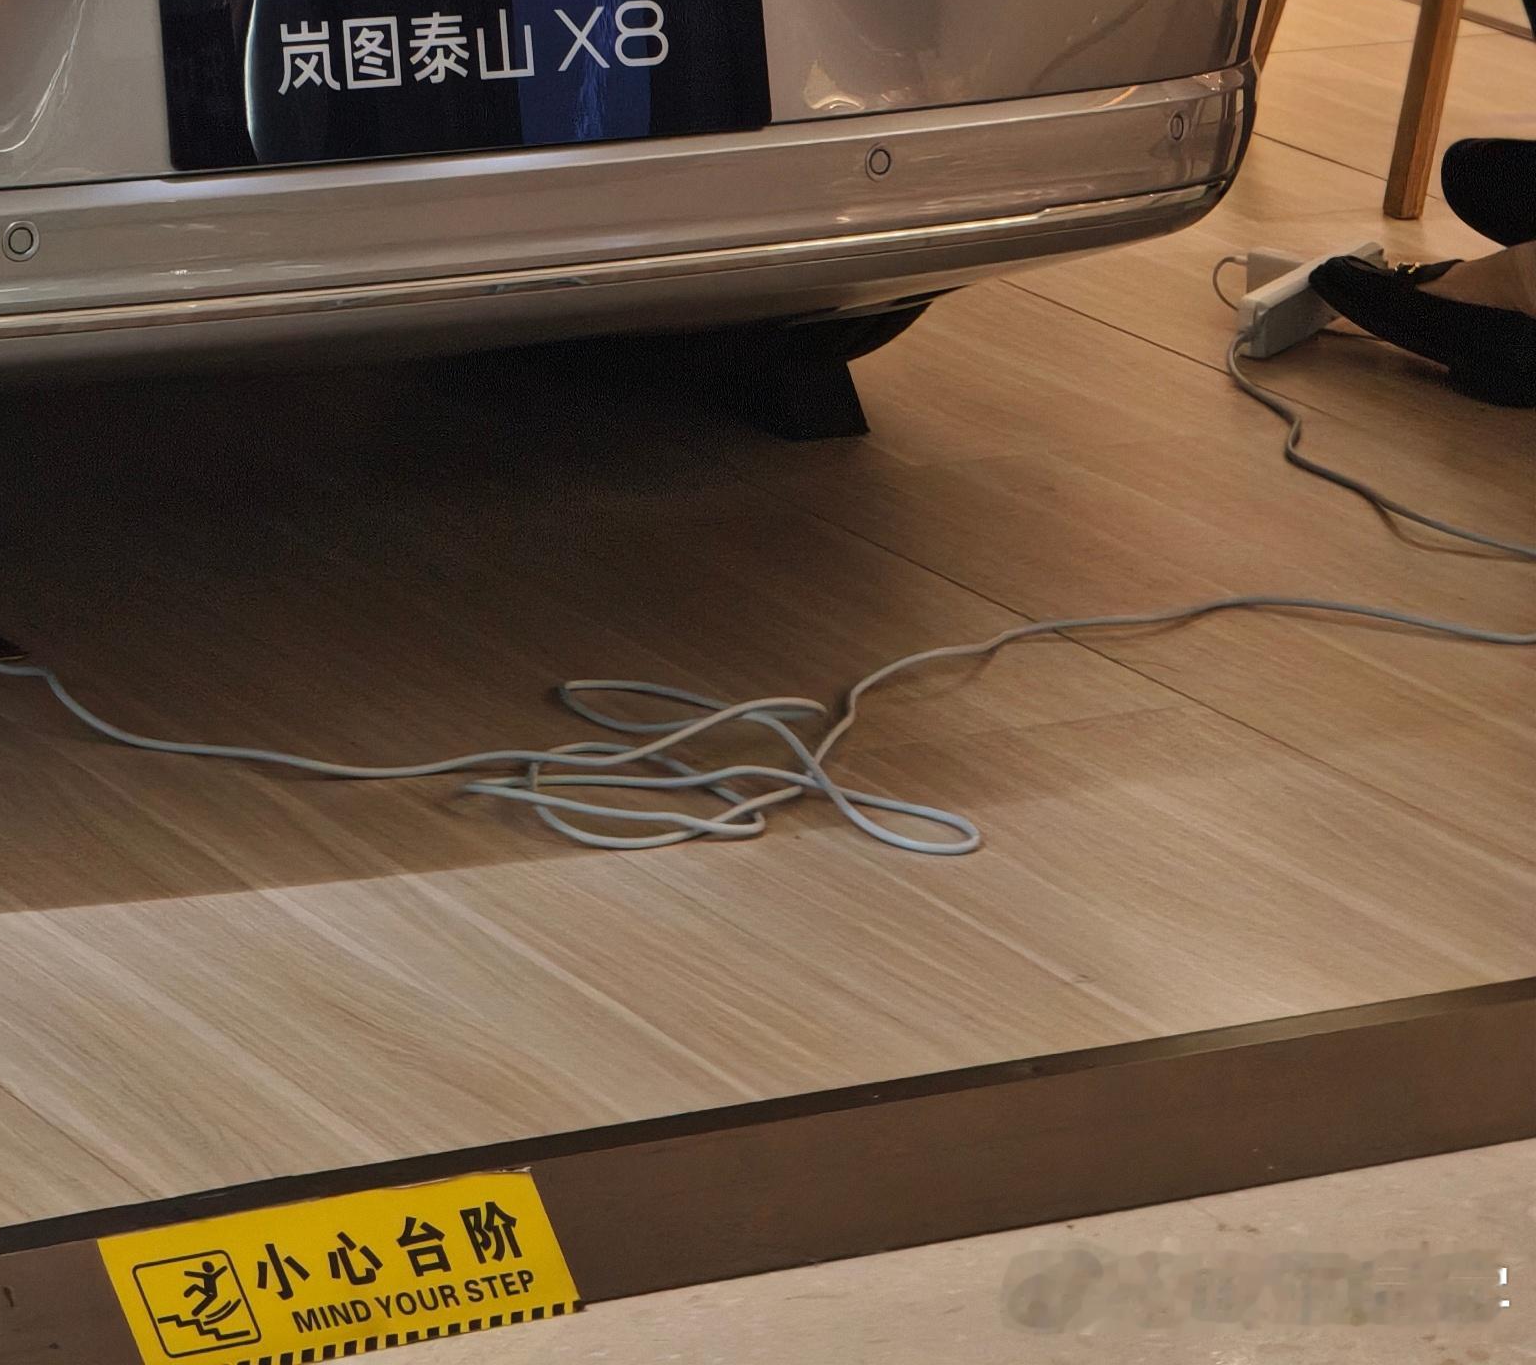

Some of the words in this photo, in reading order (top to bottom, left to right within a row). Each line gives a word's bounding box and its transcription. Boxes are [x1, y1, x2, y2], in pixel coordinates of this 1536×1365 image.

[278, 9, 535, 95] 岚图泰山
[554, 0, 669, 72] X8
[256, 1201, 524, 1300] 小心台阶
[292, 1299, 371, 1333] MIND
[373, 1285, 459, 1321] YOUR
[468, 1270, 535, 1302] STEP
